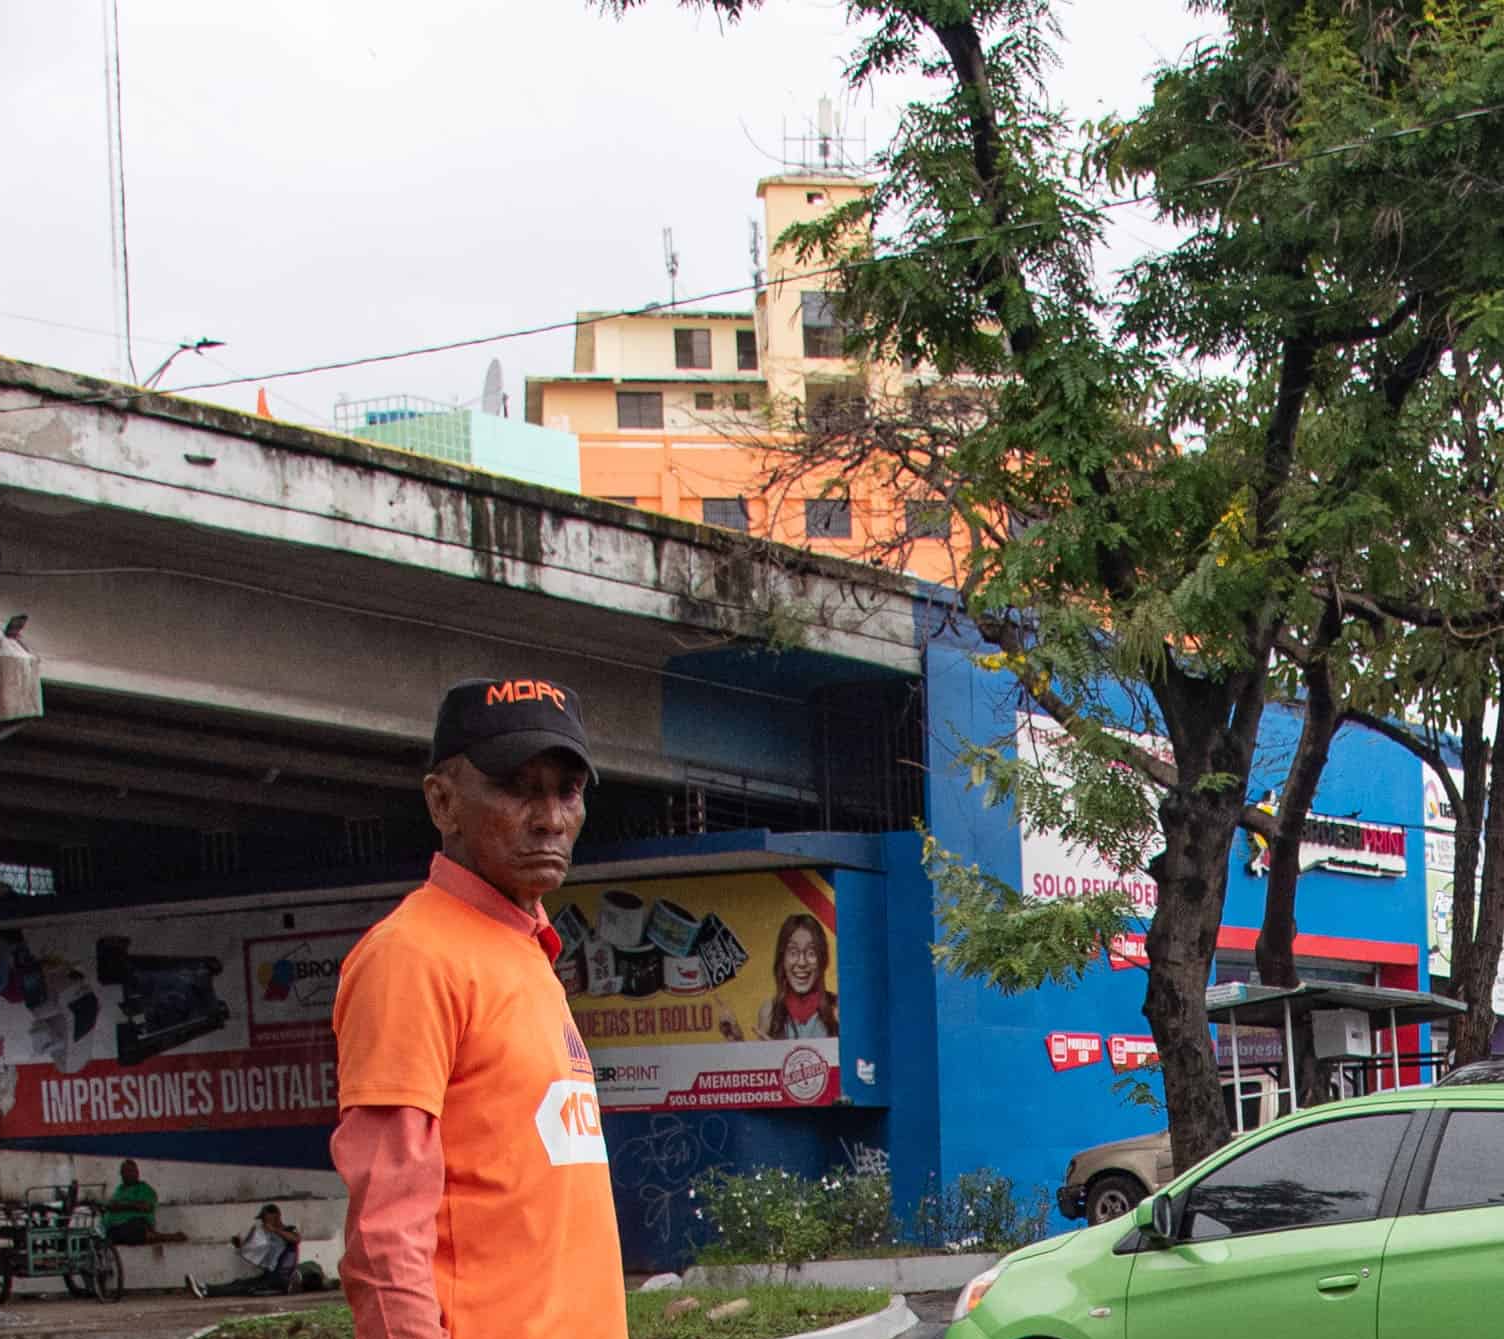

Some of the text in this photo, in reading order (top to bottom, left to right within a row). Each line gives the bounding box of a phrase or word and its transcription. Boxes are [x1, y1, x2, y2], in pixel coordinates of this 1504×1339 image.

[1033, 872, 1078, 898] SOLO
[634, 1007, 656, 1035] EN
[660, 1003, 713, 1034] ROLLO
[698, 1072, 779, 1090] MEMBRESIA
[41, 1069, 213, 1124] IMPRESIONES
[669, 1089, 783, 1107] SOLO REVENDEDORES
